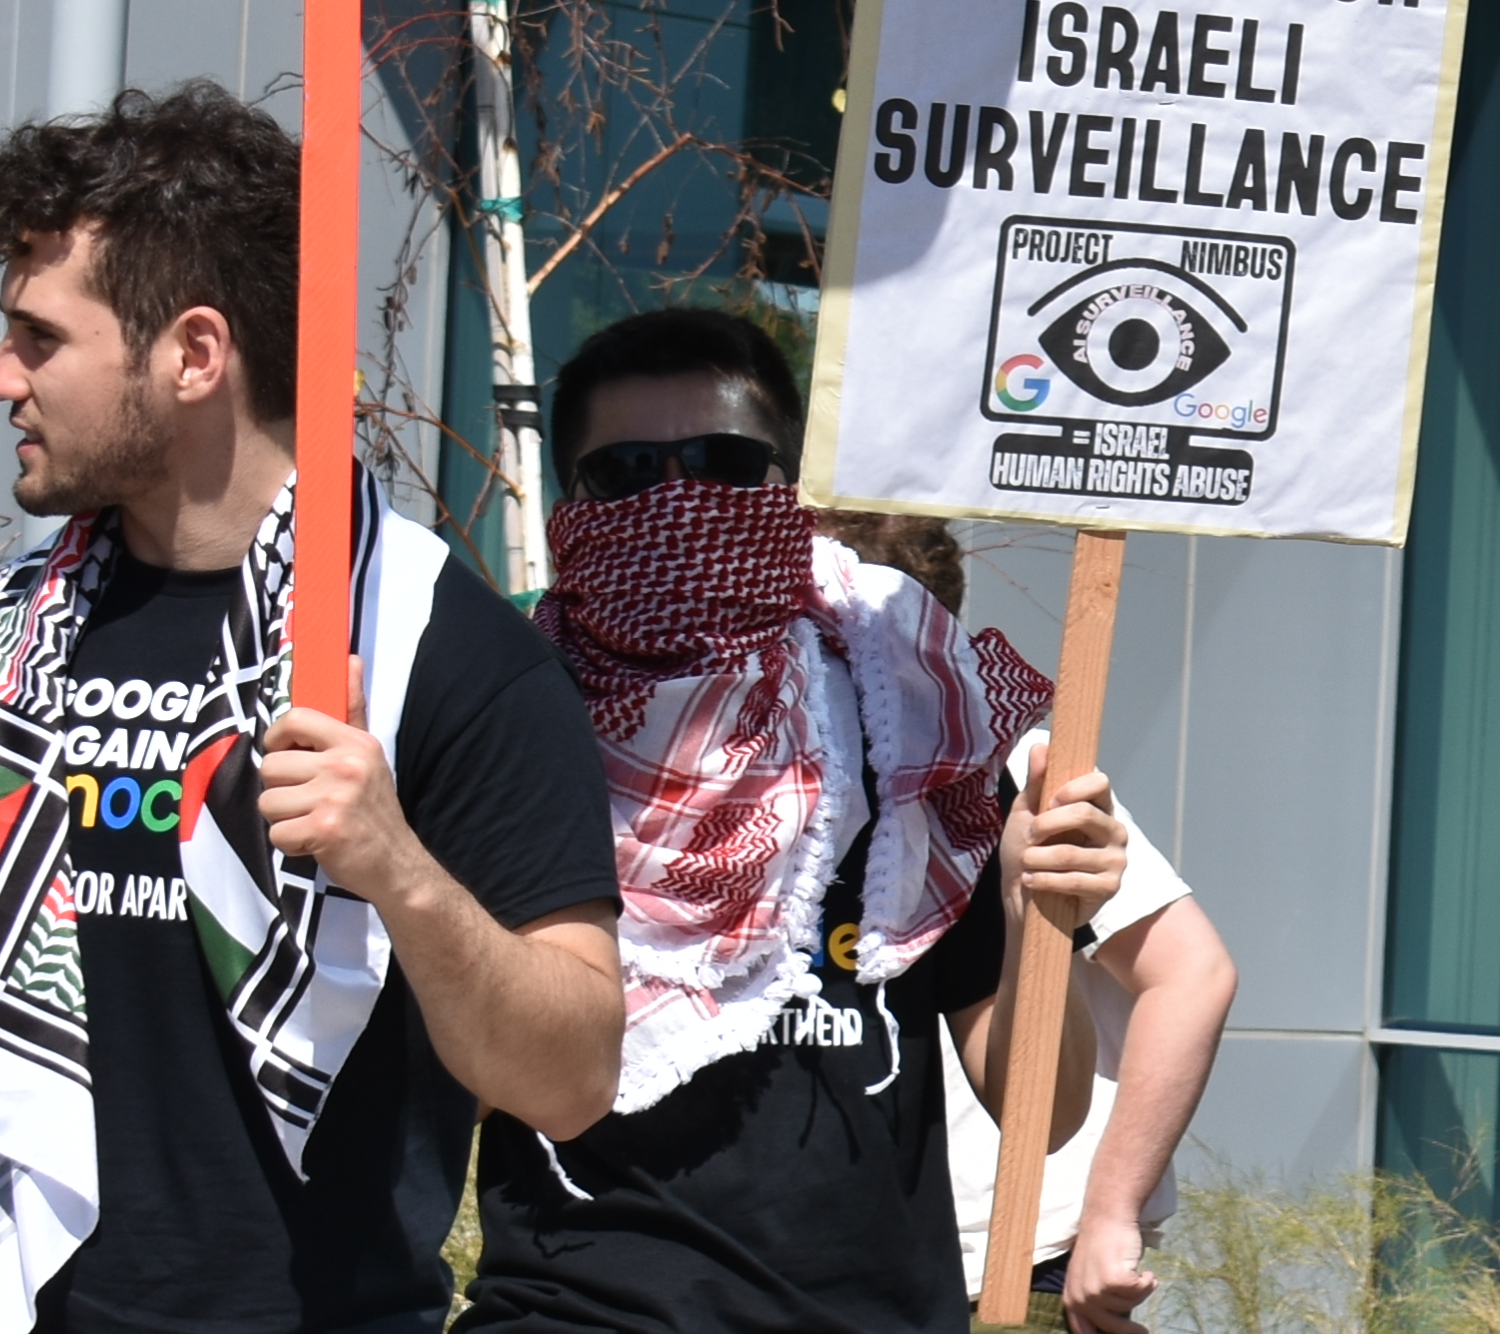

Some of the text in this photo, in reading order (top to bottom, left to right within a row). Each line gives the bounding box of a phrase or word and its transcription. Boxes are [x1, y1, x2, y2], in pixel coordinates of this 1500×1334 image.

[1016, 0, 1306, 106] ISRAELI
[873, 98, 1425, 225] SURVEILLANCE
[1012, 228, 1284, 282] PROJECT NIMBUS
[1072, 284, 1196, 378] AI SURVEILLANCE
[1173, 392, 1268, 429] Google
[1094, 423, 1170, 460] ISRAEL
[992, 453, 1249, 503] HUMAN RIGHTS ABUSE
